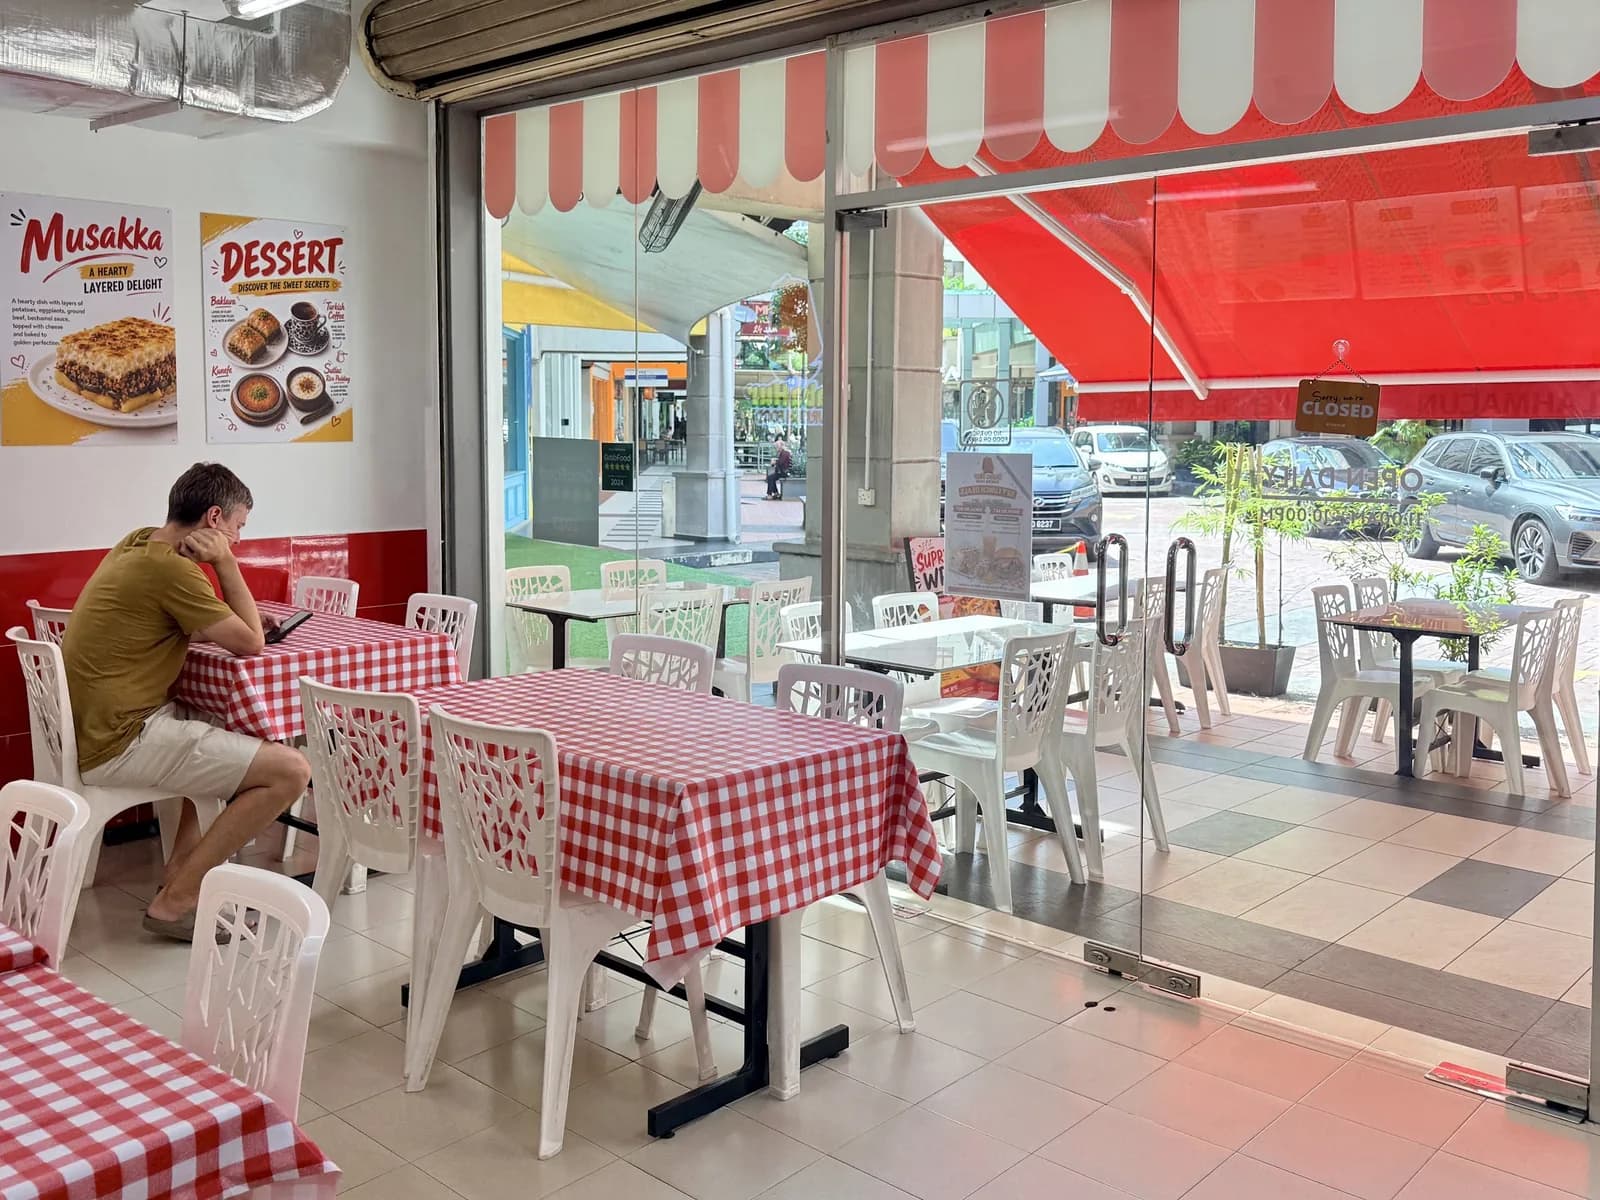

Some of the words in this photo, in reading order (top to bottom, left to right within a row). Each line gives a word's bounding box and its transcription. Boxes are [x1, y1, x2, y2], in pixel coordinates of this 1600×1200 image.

[20, 212, 164, 274] Musakka
[220, 237, 343, 283] DESSERT
[89, 267, 95, 277] A
[97, 265, 128, 277] HEARTY
[84, 281, 125, 294] LAYERED
[126, 278, 163, 291] DELIGHT
[238, 282, 268, 293] DISCOVER
[269, 281, 281, 290] THE
[282, 280, 303, 290] SWEET
[304, 279, 330, 289] SECRETS
[17, 298, 35, 306] hearty
[210, 295, 237, 307] Baklava
[325, 301, 345, 311] Turkish
[327, 310, 345, 321] Coffee
[1302, 400, 1374, 419] CLOSED
